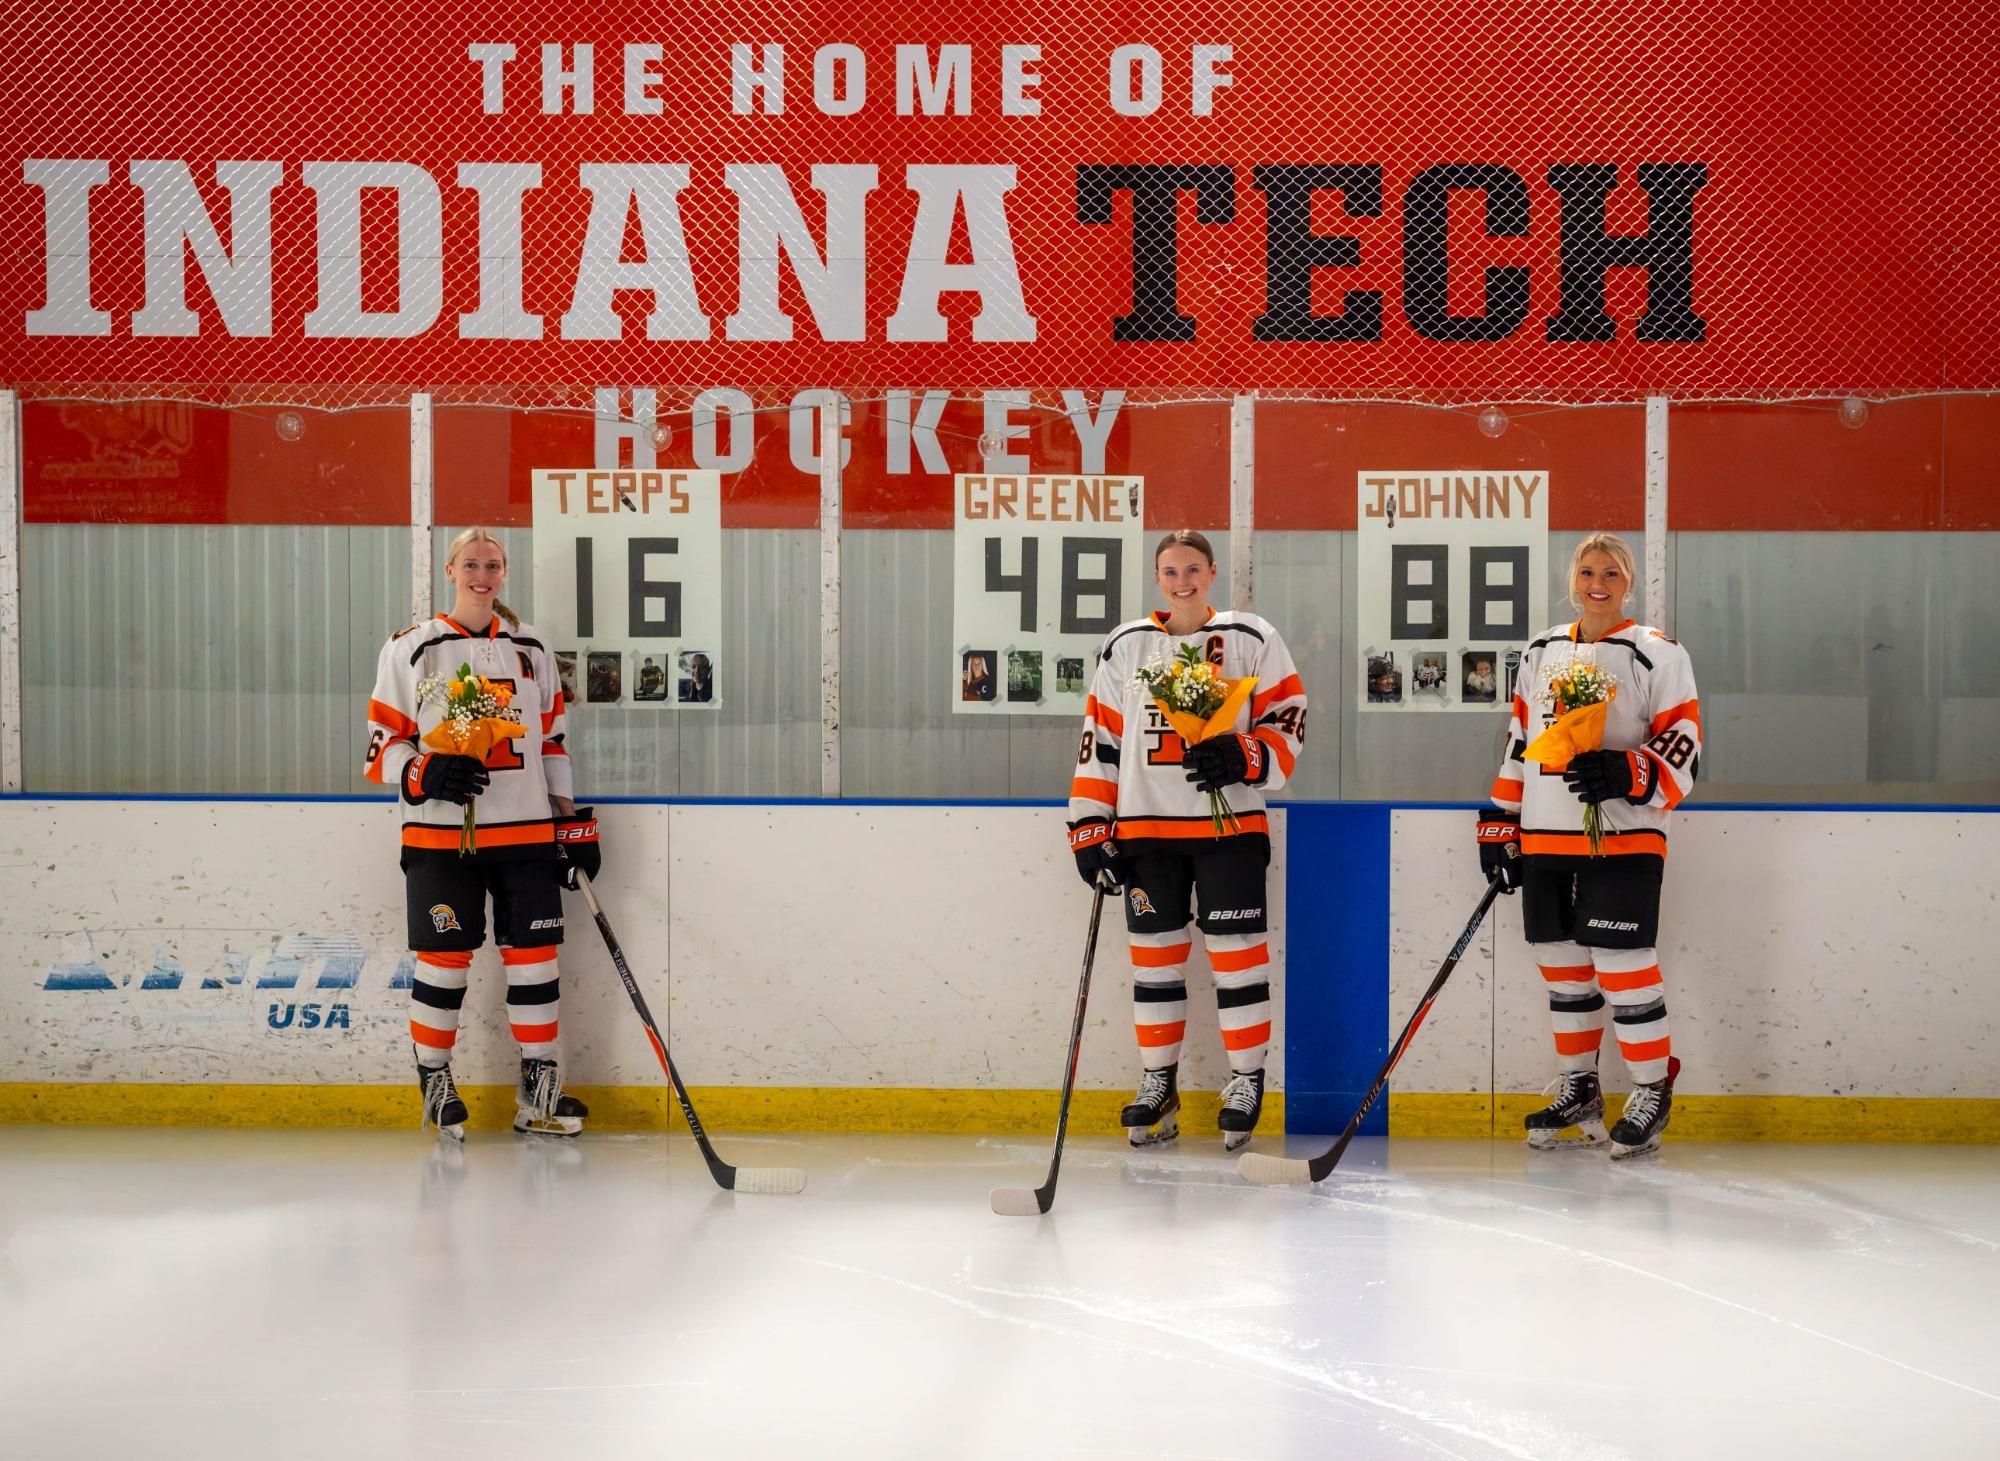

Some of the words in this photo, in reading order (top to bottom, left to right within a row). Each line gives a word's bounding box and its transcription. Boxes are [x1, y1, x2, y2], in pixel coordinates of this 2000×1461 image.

[468, 43, 664, 115] THE
[731, 43, 1042, 116] HOME
[1109, 44, 1233, 117] OF
[23, 158, 1037, 343] INDIANA
[1076, 163, 1708, 344] TECH
[594, 387, 1127, 475] HOCKEY
[547, 472, 690, 514] TERPS
[964, 477, 1125, 522] GREENE
[1365, 474, 1542, 519] JOHNNY
[576, 536, 682, 638] 16
[985, 536, 1123, 634] 48
[1391, 544, 1530, 641] 88
[1148, 712, 1170, 728] TE
[365, 729, 385, 763] 6
[1077, 730, 1095, 765] 8
[1646, 730, 1695, 771] 88
[267, 1003, 351, 1030] USA
